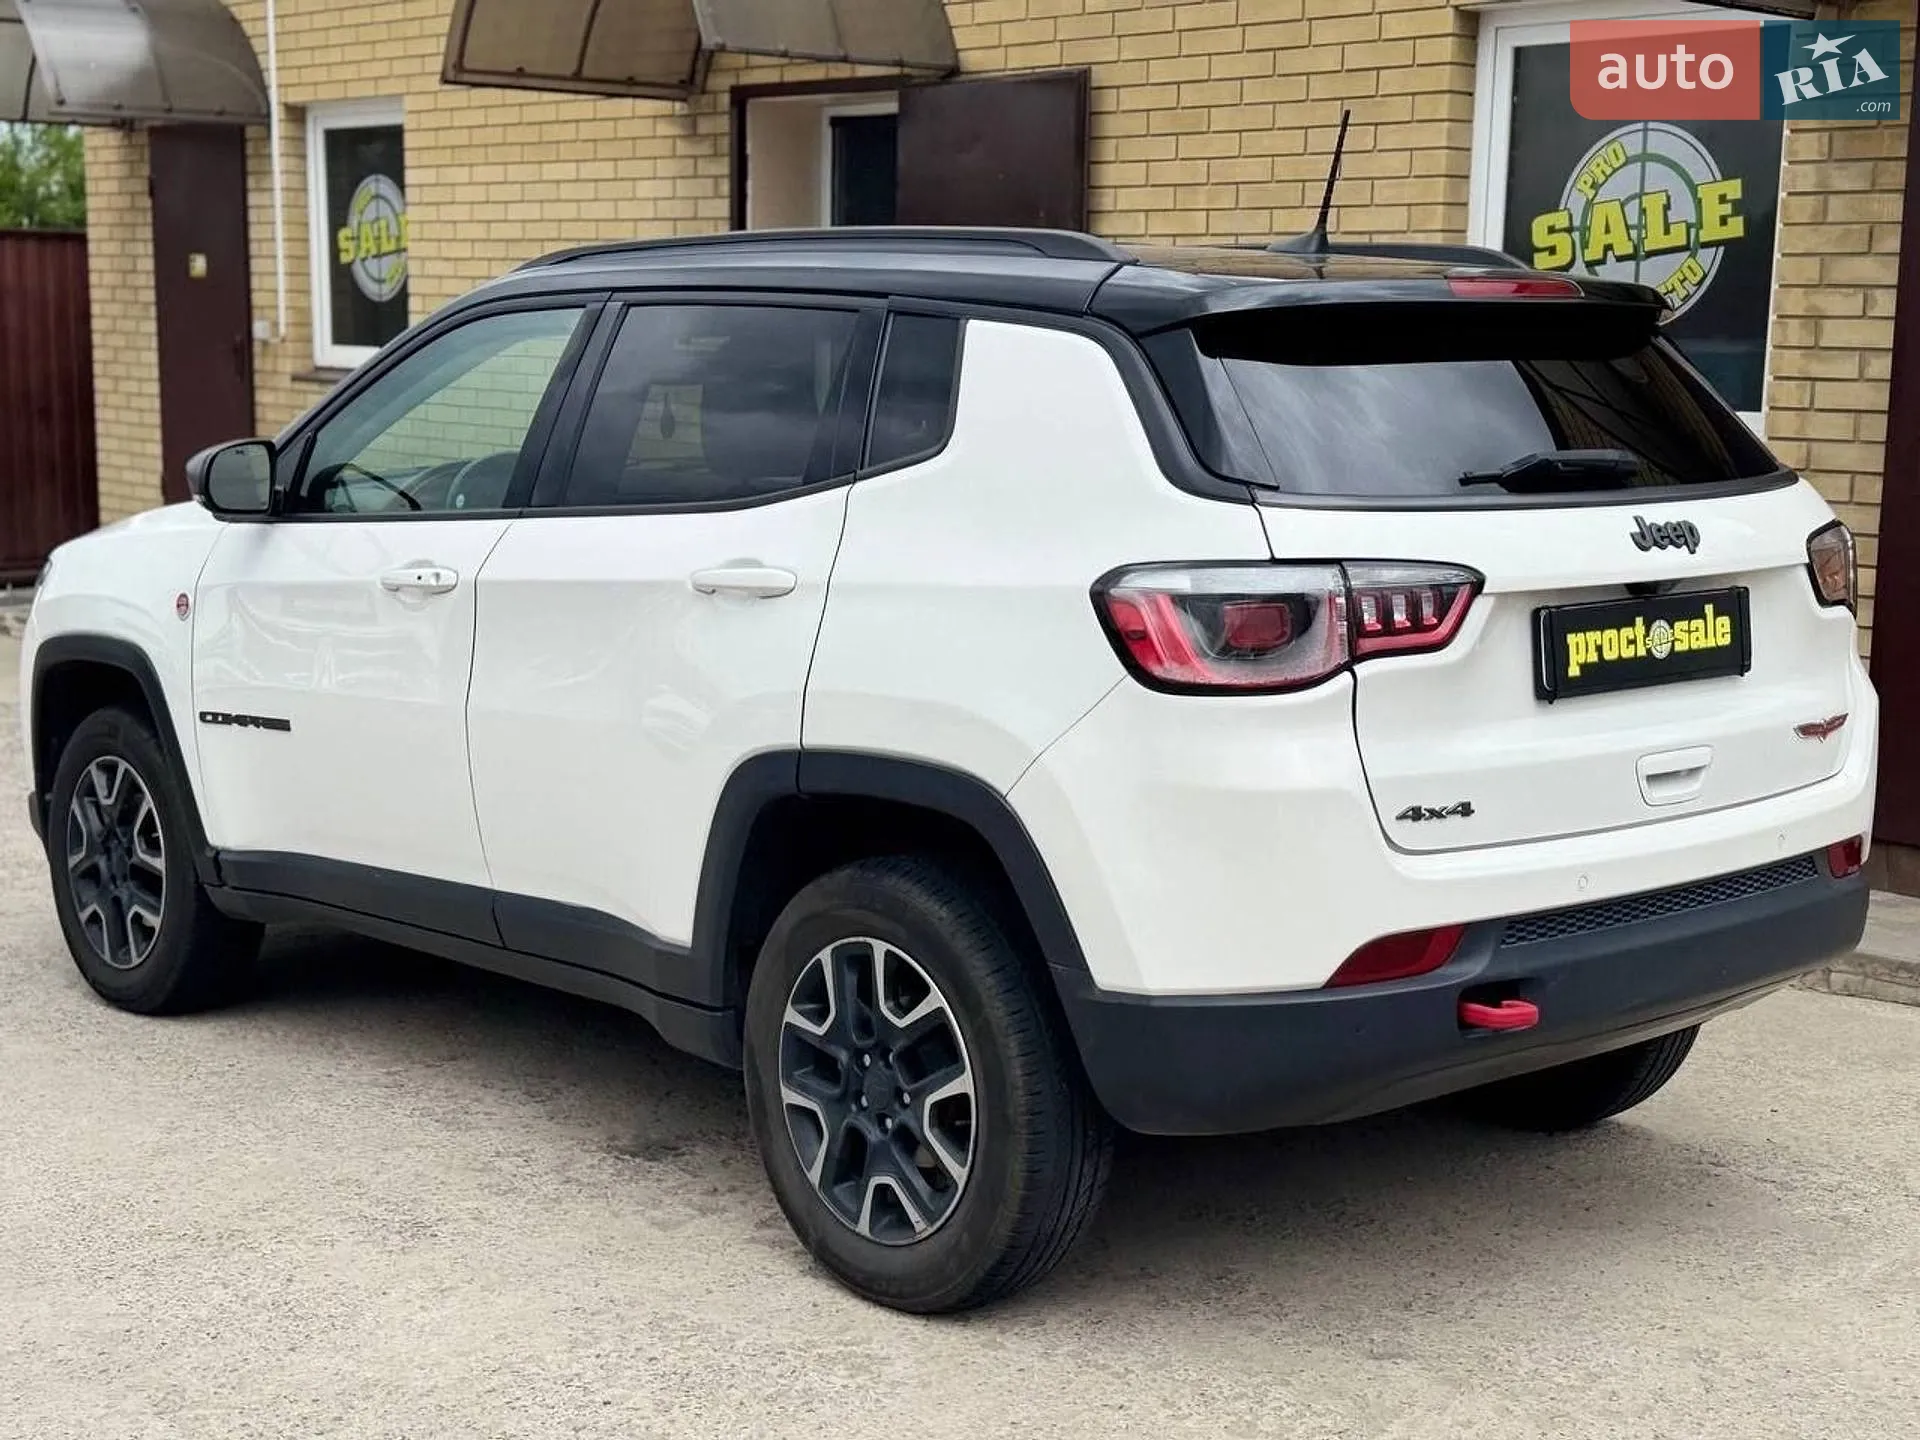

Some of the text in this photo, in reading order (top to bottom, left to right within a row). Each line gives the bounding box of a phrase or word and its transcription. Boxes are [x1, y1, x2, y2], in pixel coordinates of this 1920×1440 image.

[1575, 139, 1628, 200] PRO
[1531, 178, 1745, 271] SALE
[1656, 257, 1707, 303] TO
[1630, 515, 1700, 555] Jeep
[1566, 604, 1731, 678] proct sale
[1395, 800, 1475, 822] 4x4
